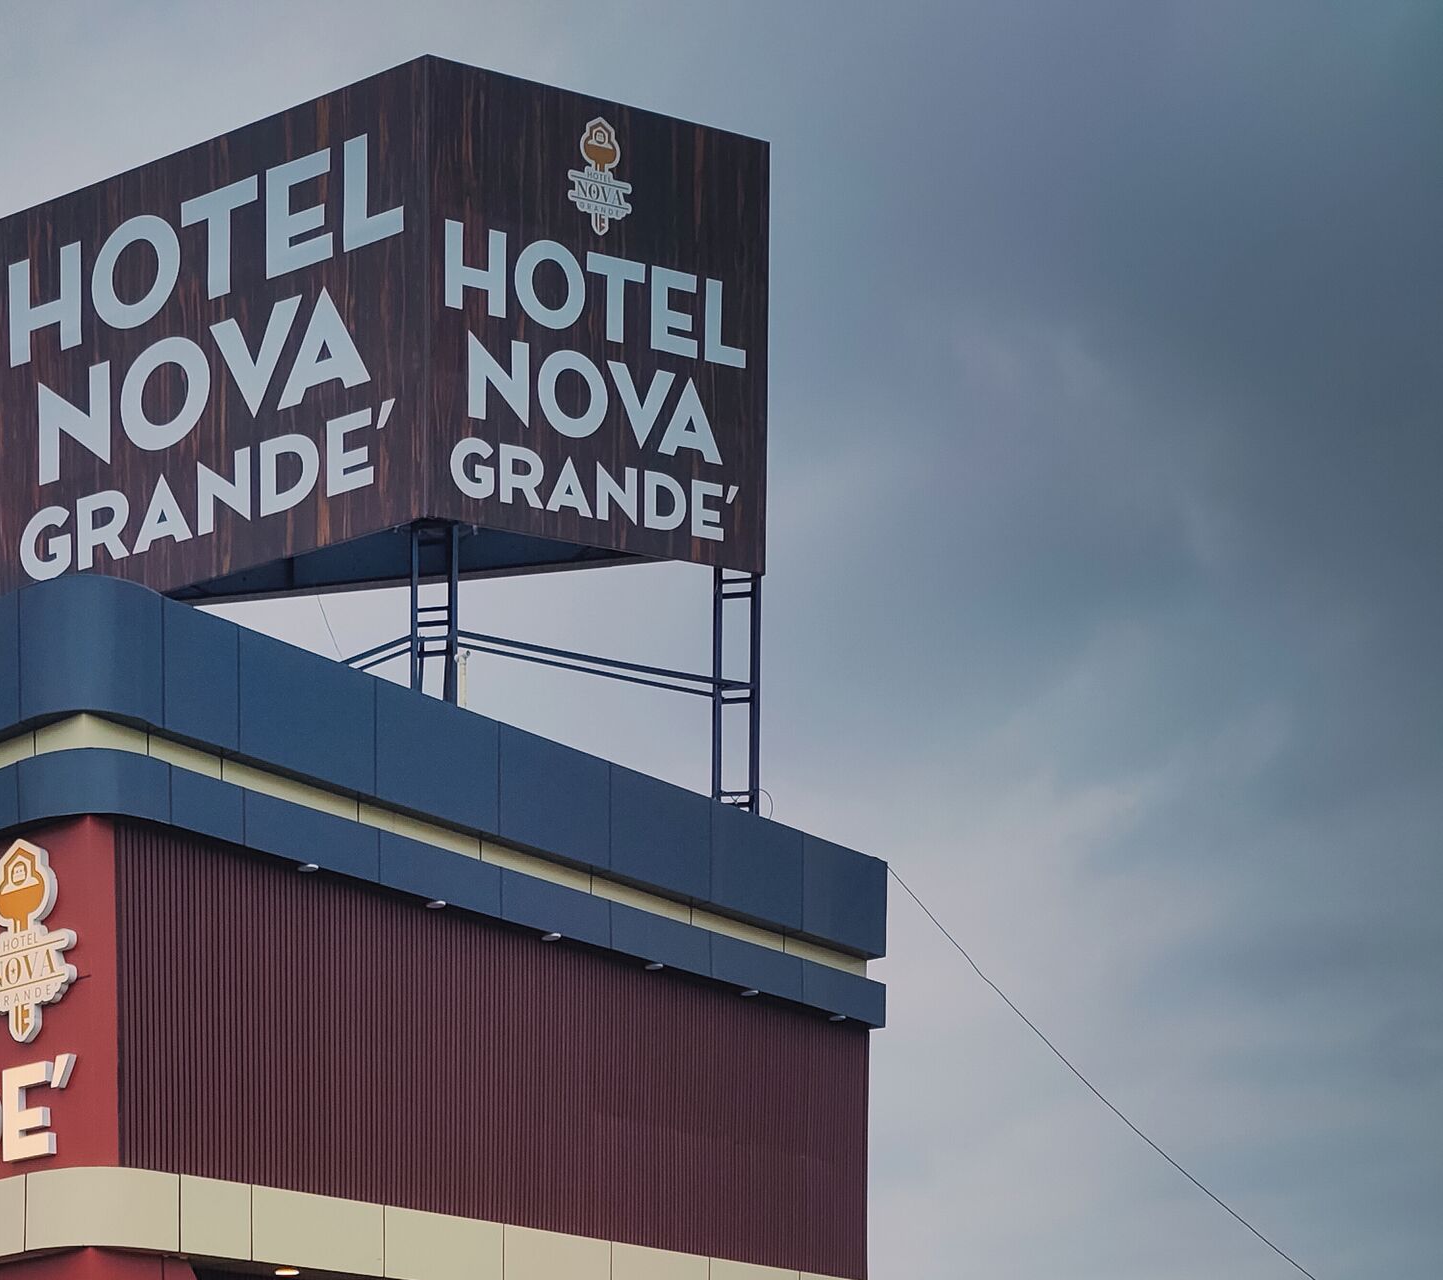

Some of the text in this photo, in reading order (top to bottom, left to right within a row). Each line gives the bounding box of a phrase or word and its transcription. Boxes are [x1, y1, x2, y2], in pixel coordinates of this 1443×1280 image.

[8, 133, 404, 368] HOTEL
[577, 181, 623, 206] NOVA
[445, 218, 747, 369] HOTEL
[38, 287, 372, 486] NOVA
[467, 331, 723, 465] NOVA
[3, 932, 39, 952] HOTEL
